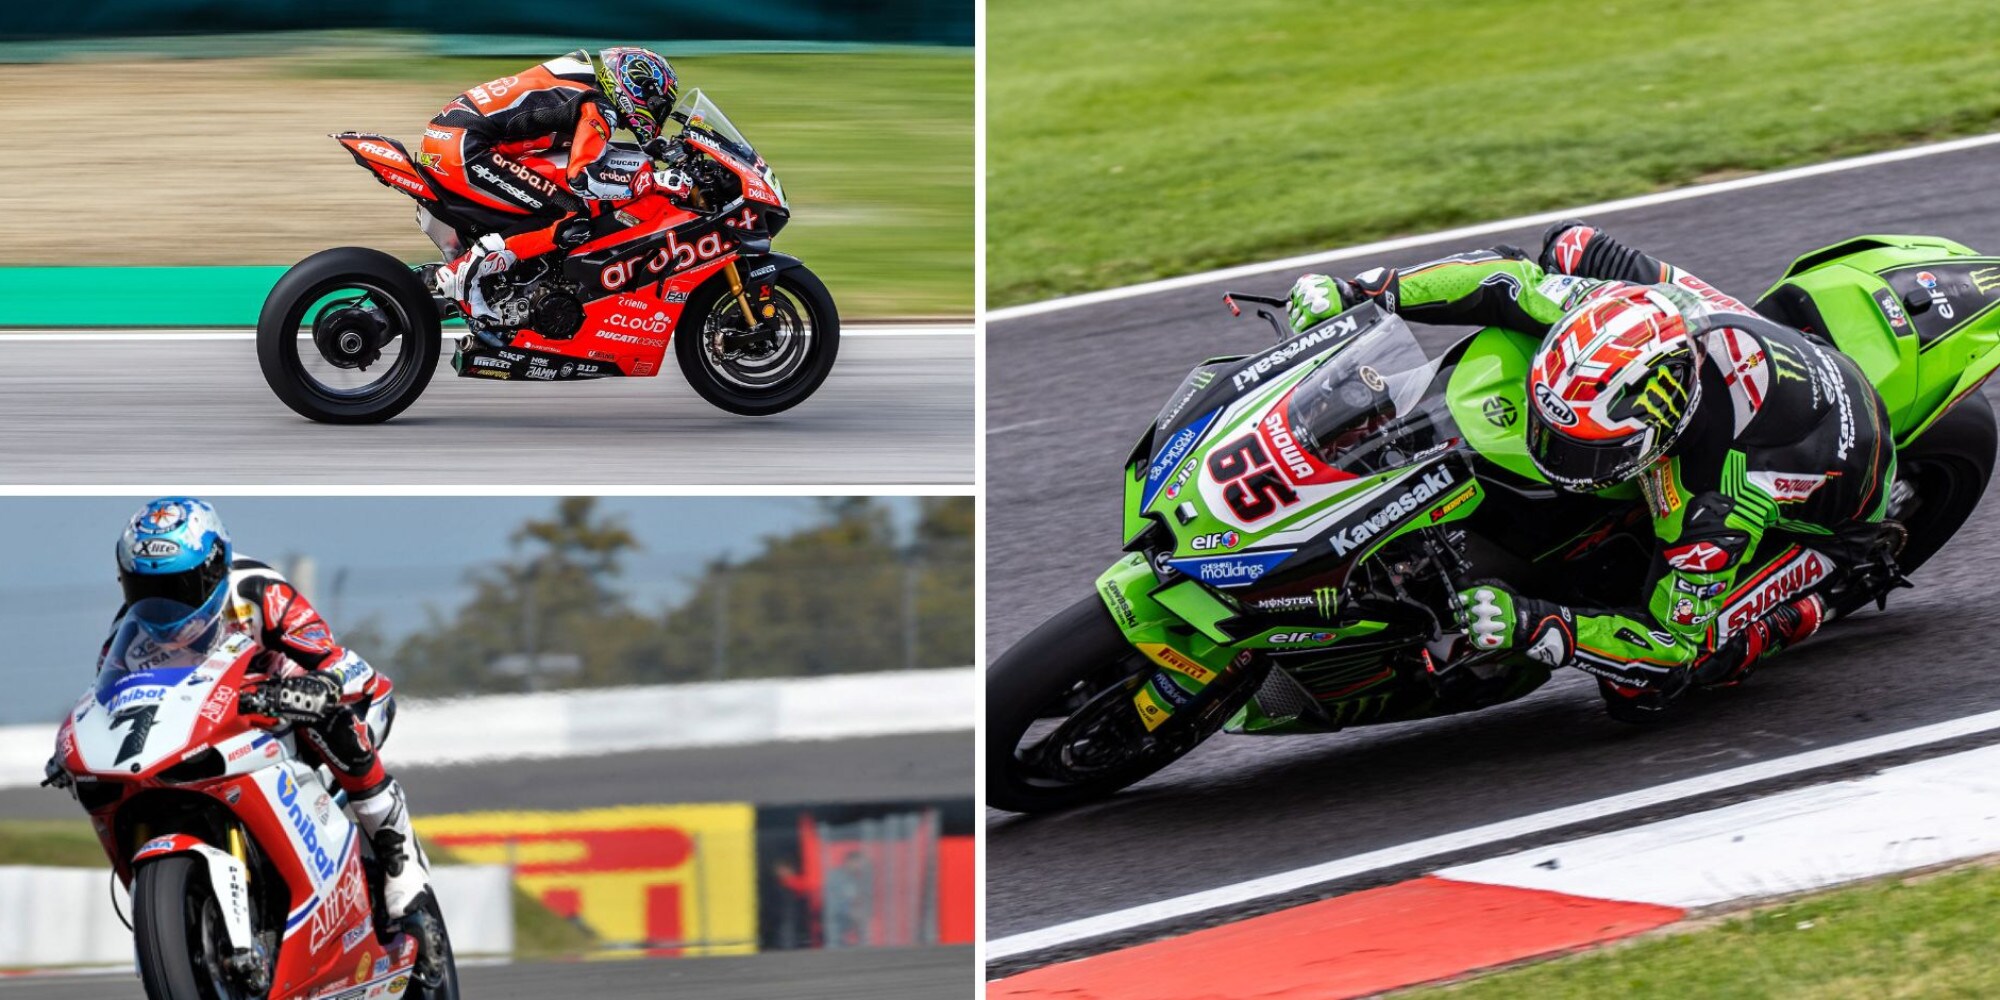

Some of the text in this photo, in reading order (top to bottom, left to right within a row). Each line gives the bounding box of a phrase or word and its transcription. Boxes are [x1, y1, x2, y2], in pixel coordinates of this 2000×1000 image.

[357, 142, 404, 162] FREZA
[470, 163, 543, 209] alpinestars
[492, 153, 558, 197] aruba.it
[1927, 288, 1955, 320] elf
[595, 330, 637, 344] DUCATI
[473, 356, 512, 369] PIRELLI
[499, 351, 525, 361] SKF
[1232, 316, 1358, 391] Kawasaki
[1538, 391, 1571, 420] Arai
[1265, 412, 1315, 479] SHOWA
[1176, 457, 1198, 486] elf
[1207, 432, 1301, 523] 65
[1329, 464, 1455, 557] Kawasaki
[1191, 532, 1223, 550] elf
[1201, 563, 1264, 579] mouldings
[1106, 579, 1139, 628] Kawasaki
[1258, 596, 1313, 608] MONSTER
[1727, 552, 1824, 637] SHOWA
[1268, 632, 1312, 643] elf
[1157, 647, 1208, 679] PIRELLI
[109, 704, 160, 767] 7
[277, 769, 334, 881] Unibat
